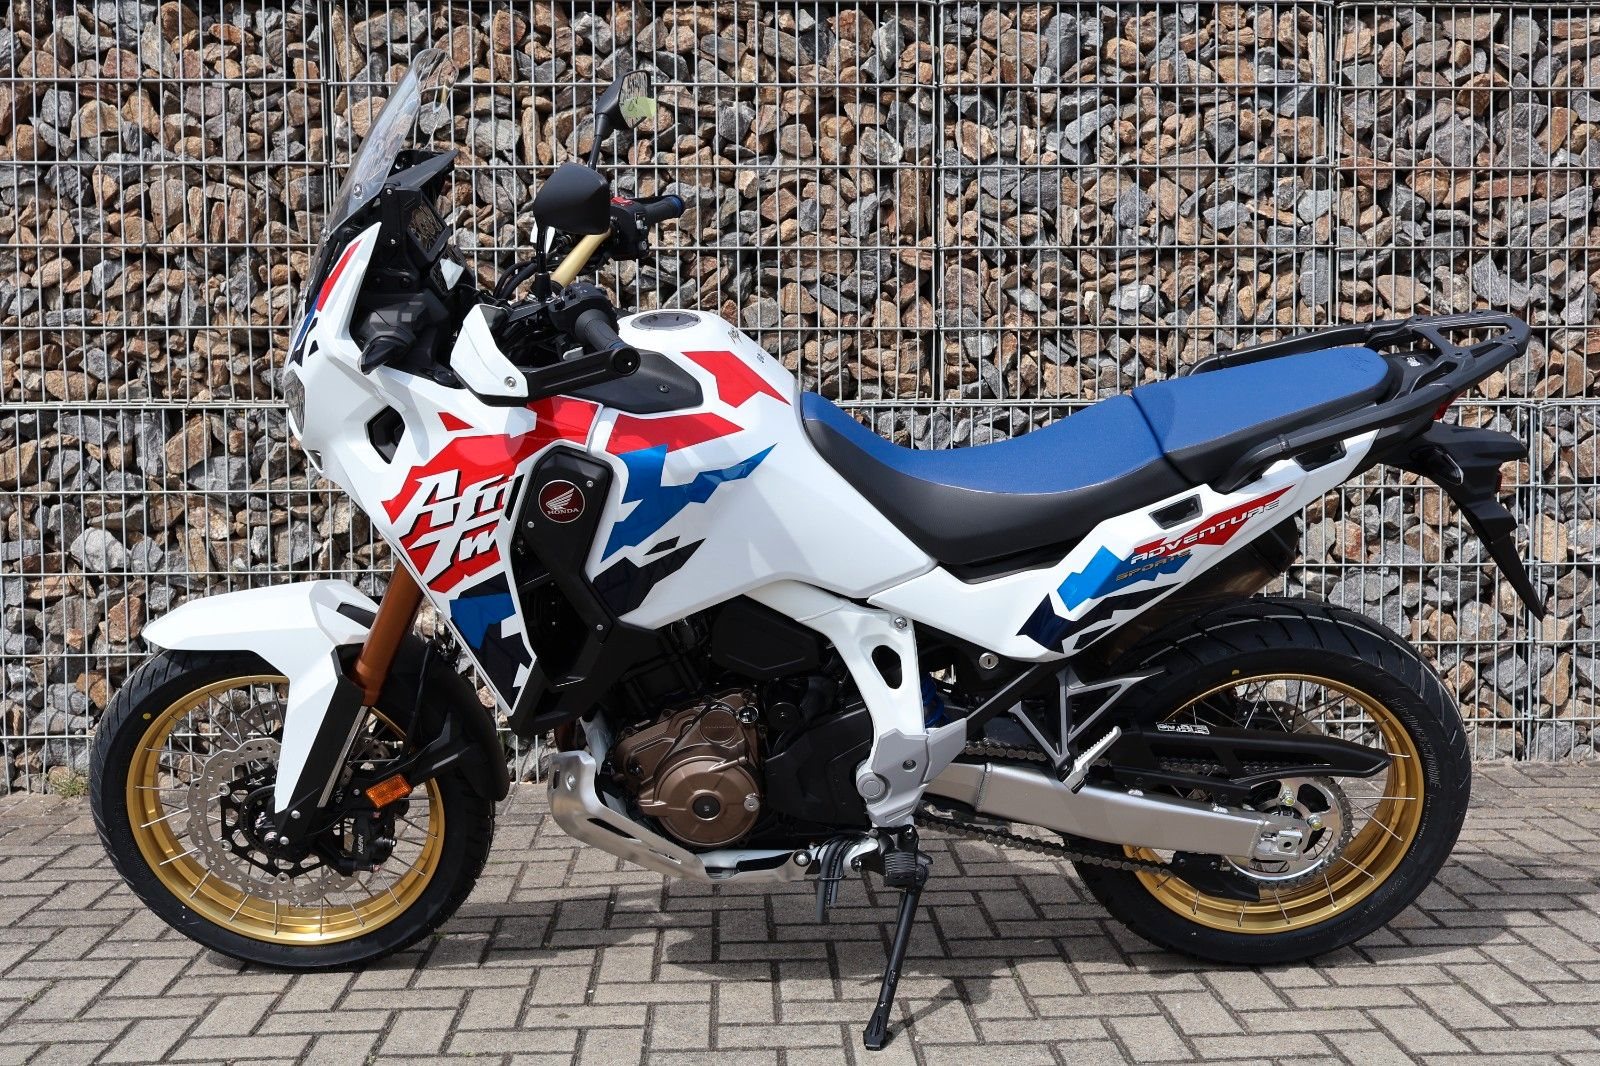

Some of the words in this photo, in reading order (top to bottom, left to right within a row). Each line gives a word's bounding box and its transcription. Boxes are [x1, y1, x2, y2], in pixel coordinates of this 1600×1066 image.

[547, 507, 580, 515] HONDA
[1131, 499, 1280, 565] ADVENTURE
[1116, 550, 1192, 582] SPORTS
